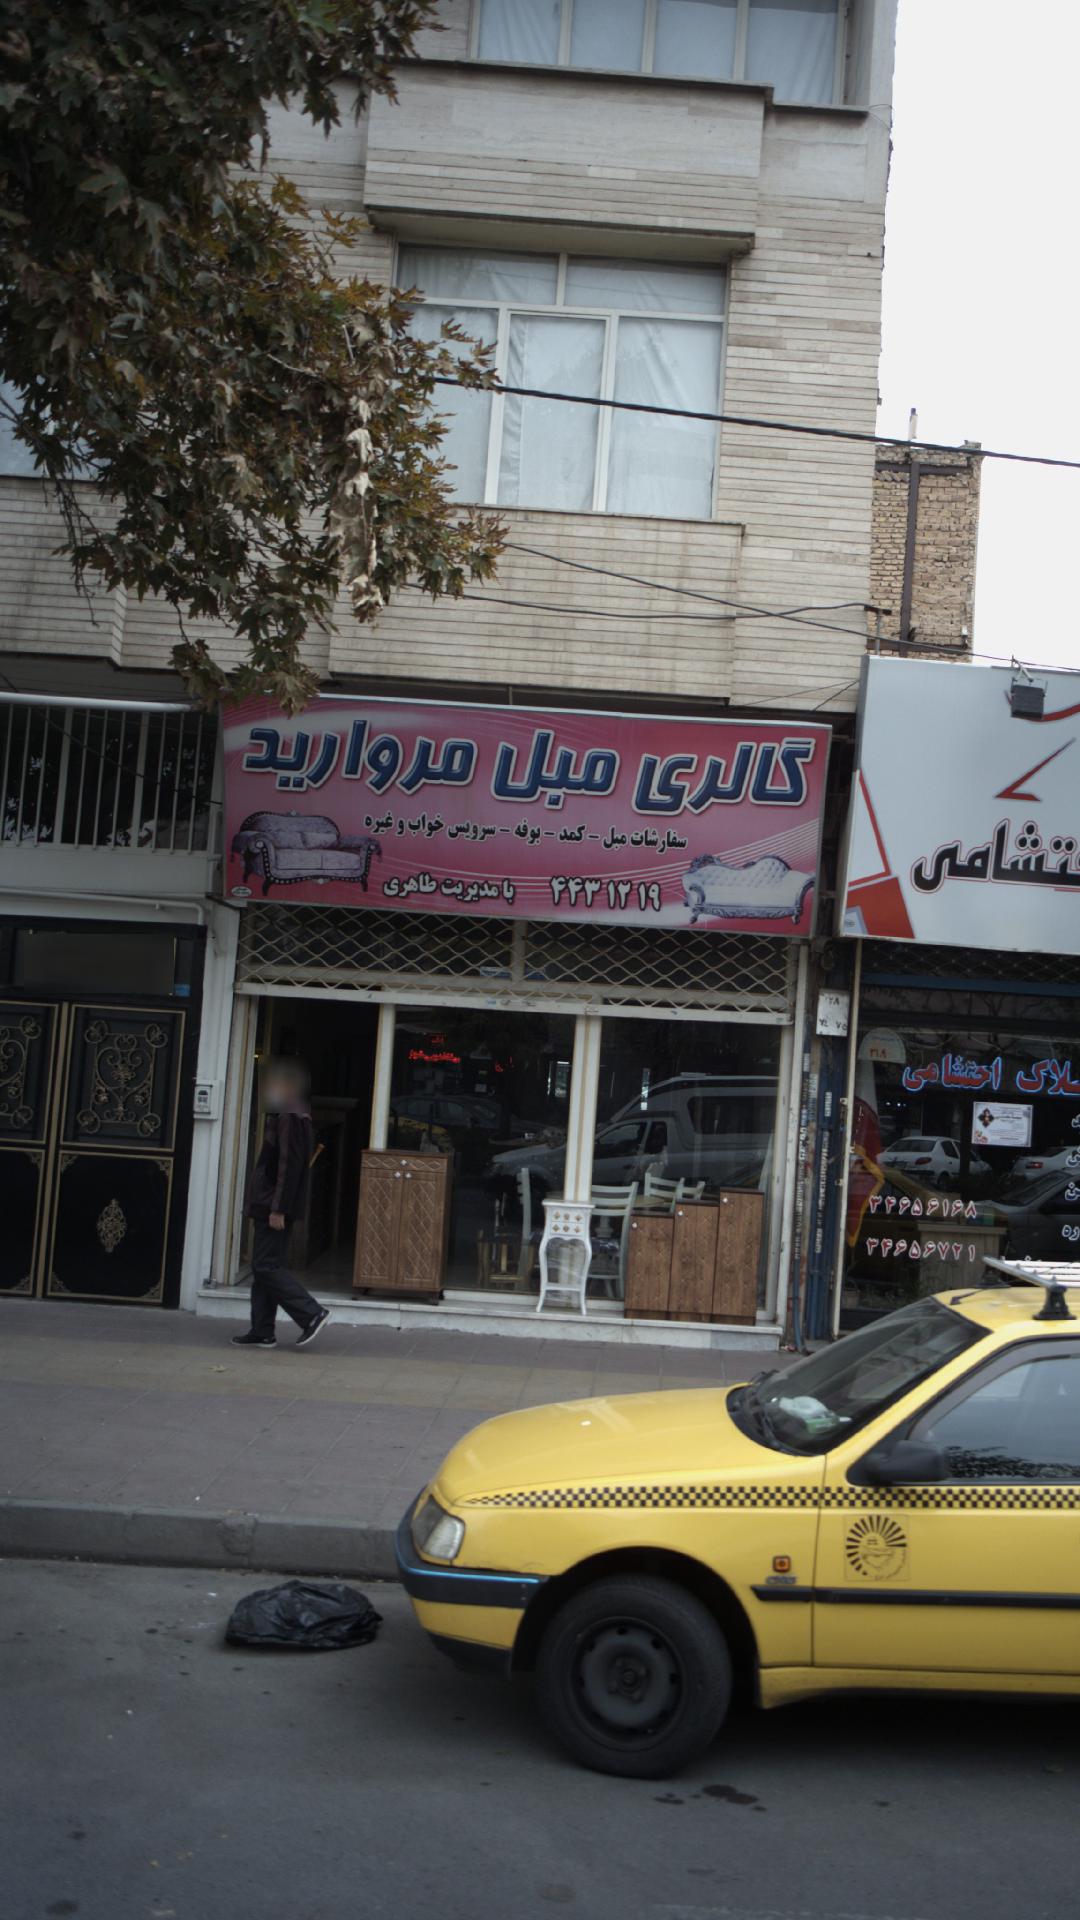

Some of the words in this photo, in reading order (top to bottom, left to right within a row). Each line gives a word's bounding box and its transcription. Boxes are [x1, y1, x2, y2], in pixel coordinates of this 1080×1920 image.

[242, 718, 478, 795] مروارید
[490, 728, 621, 810] مبل
[631, 737, 816, 815] گالری
[364, 810, 394, 835] غیره
[396, 821, 406, 837] و
[408, 812, 444, 837] خواب
[447, 821, 497, 842] سرویس
[514, 818, 541, 845] بوفه
[559, 824, 587, 843] کمد
[602, 826, 627, 850] مبل
[631, 829, 688, 854] سفارشات
[910, 818, 1080, 893] تشامی
[383, 872, 439, 899] طاهری
[440, 878, 499, 903] مدیریت
[501, 878, 517, 905] با
[902, 1052, 1003, 1091] احتشامی
[869, 1195, 977, 1219] ۳۴۶۵۶۱۶۸
[865, 1236, 976, 1263] ۳۴۶۵۶۷۲۱
